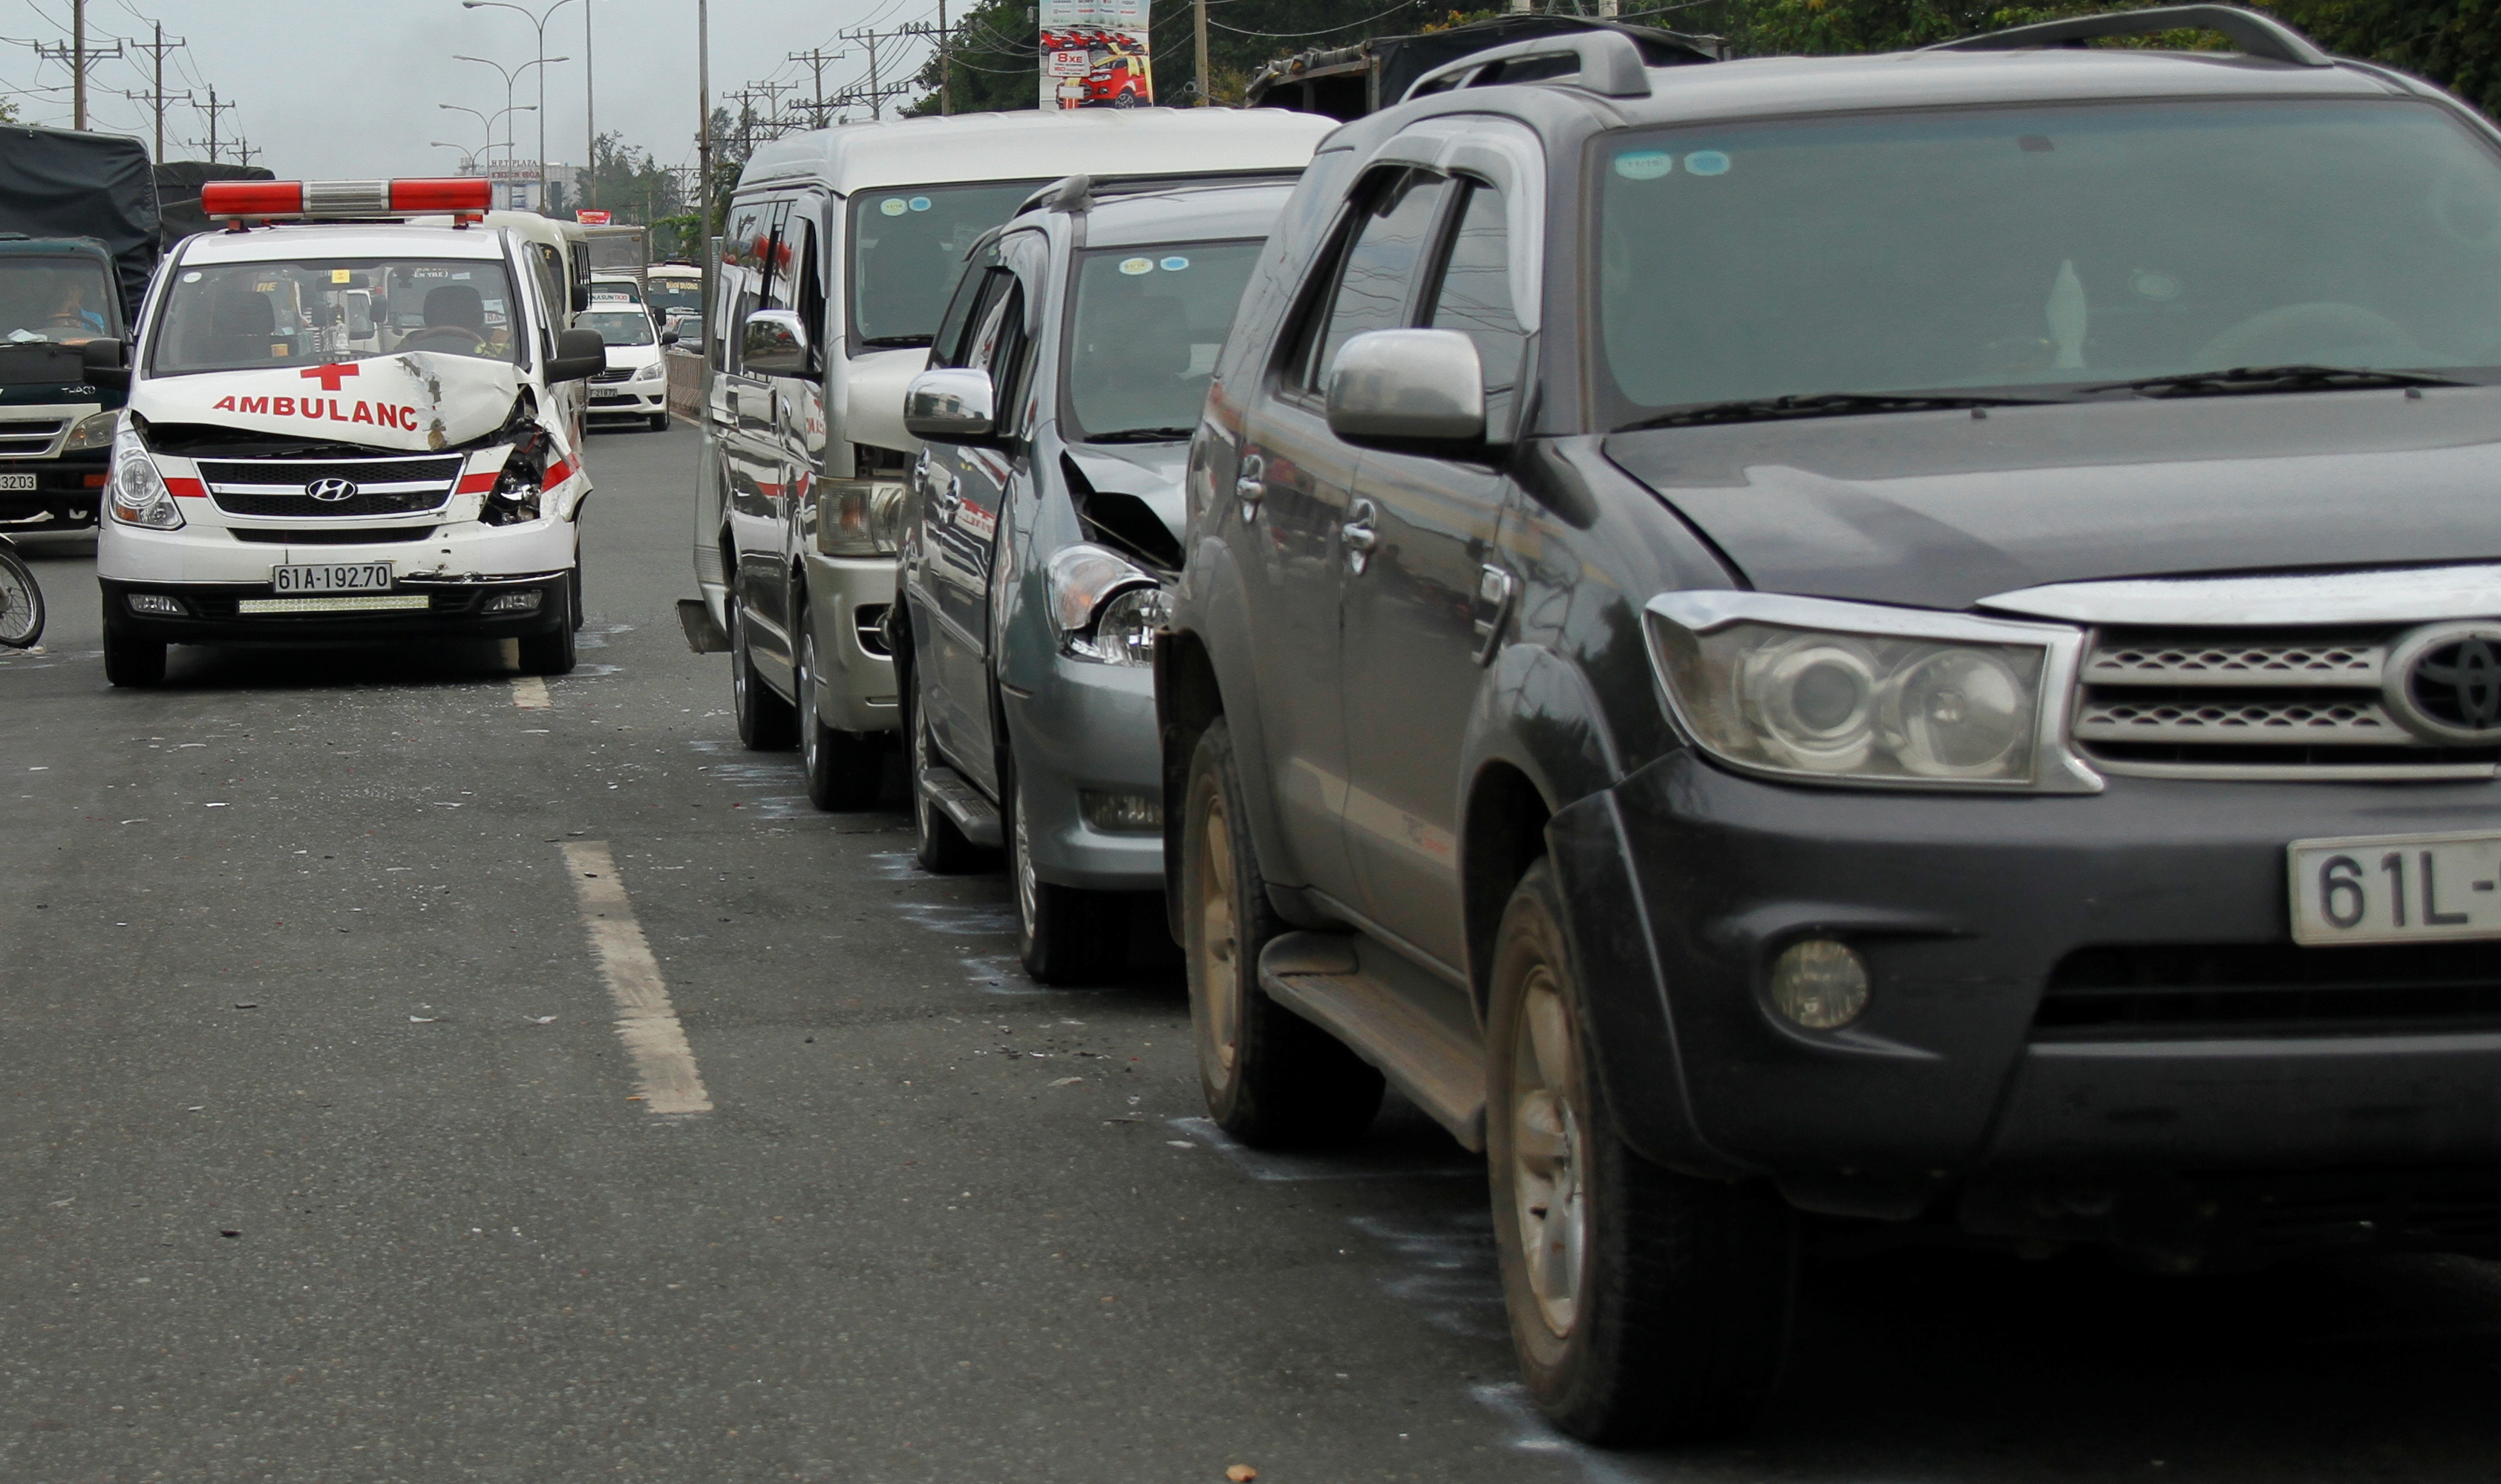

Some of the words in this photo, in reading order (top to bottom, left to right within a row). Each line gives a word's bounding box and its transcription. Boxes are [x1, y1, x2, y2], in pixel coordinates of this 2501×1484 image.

[1058, 53, 1068, 62] 8
[61, 385, 96, 394] THACO
[212, 396, 418, 431] AMBULANC
[0, 476, 33, 488] 32.03
[278, 566, 388, 589] 61A-192.70
[2318, 850, 2501, 929] 61L-
